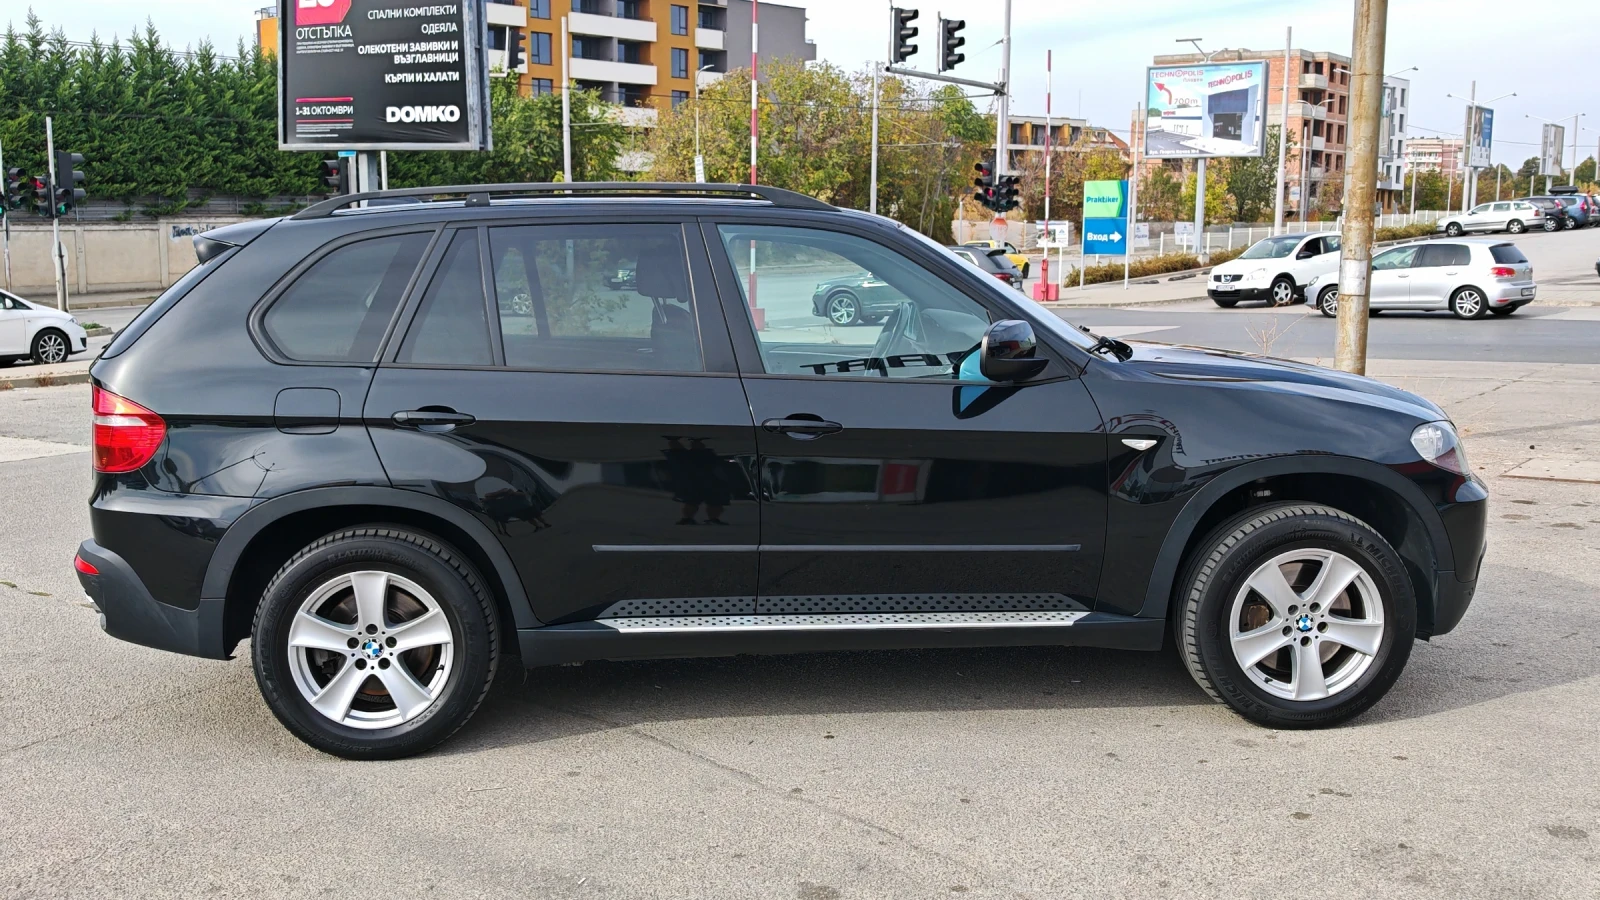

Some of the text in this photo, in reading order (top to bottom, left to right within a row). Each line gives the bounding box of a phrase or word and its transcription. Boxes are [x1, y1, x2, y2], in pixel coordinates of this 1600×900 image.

[367, 5, 457, 20] СПАЛНИ КОМПЛЕКТИ
[296, 25, 352, 40] ОТСТЪПКА
[421, 23, 458, 35] ОДЕЯЛА
[357, 43, 409, 55] ОЛЕКОТЕНИ
[409, 41, 451, 53] ЗАВИВКИ
[451, 40, 459, 51] И
[393, 53, 459, 64] ВЪЗГЛАВНИЦИ
[384, 72, 460, 83] КЪРПИ И ХАЛАТИ
[1151, 69, 1204, 79] TECHNOPOLIS
[1207, 69, 1253, 88] TECHNOPOLIS
[295, 105, 354, 116] 1-31 ОКТОМВРИ
[385, 105, 461, 123] DOMKO
[1086, 196, 1119, 204] Praktiker
[1086, 232, 1109, 242] Вход
